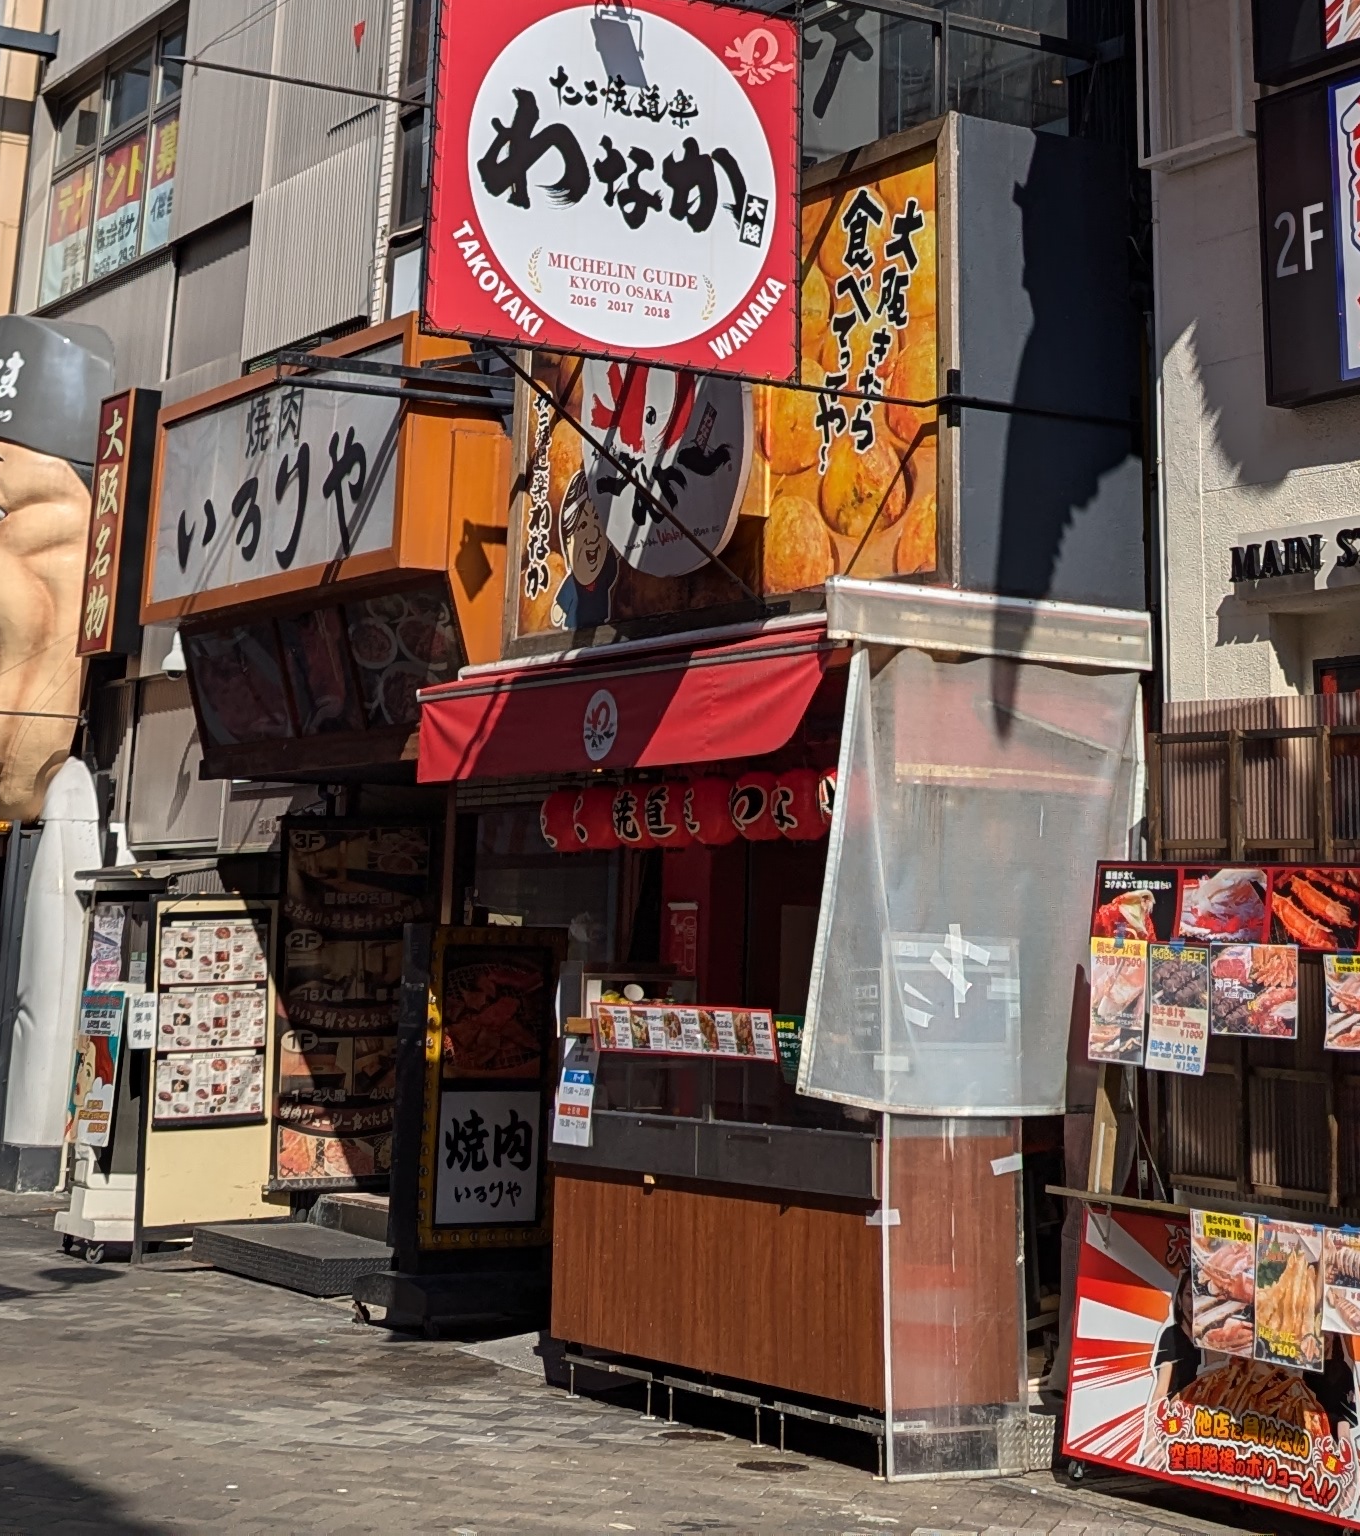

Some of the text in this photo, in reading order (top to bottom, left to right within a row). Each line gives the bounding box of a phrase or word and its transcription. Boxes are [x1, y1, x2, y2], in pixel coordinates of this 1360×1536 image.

[549, 66, 700, 129] たこ焼道楽
[477, 86, 748, 234] わなか
[742, 197, 764, 246] 大阪
[1273, 202, 1326, 279] 2F
[452, 220, 546, 338] TAKOYAKI
[547, 252, 699, 291] MICHELIN GUIDE
[568, 274, 673, 305] KYOTO OSAKA
[569, 293, 672, 320] 2016 2017 2018
[708, 277, 787, 361] WANAKA
[244, 385, 304, 459] 焼肉
[177, 426, 368, 572] いろりや
[84, 409, 124, 641] 大阪名物
[1229, 535, 1325, 585] MAIN
[295, 831, 321, 850] 3F
[290, 932, 319, 949] 2F
[286, 1033, 315, 1051] 1F
[445, 1110, 533, 1172] 焼肉
[453, 1181, 523, 1208] いろりや
[1192, 1408, 1311, 1459] 他店に負けない
